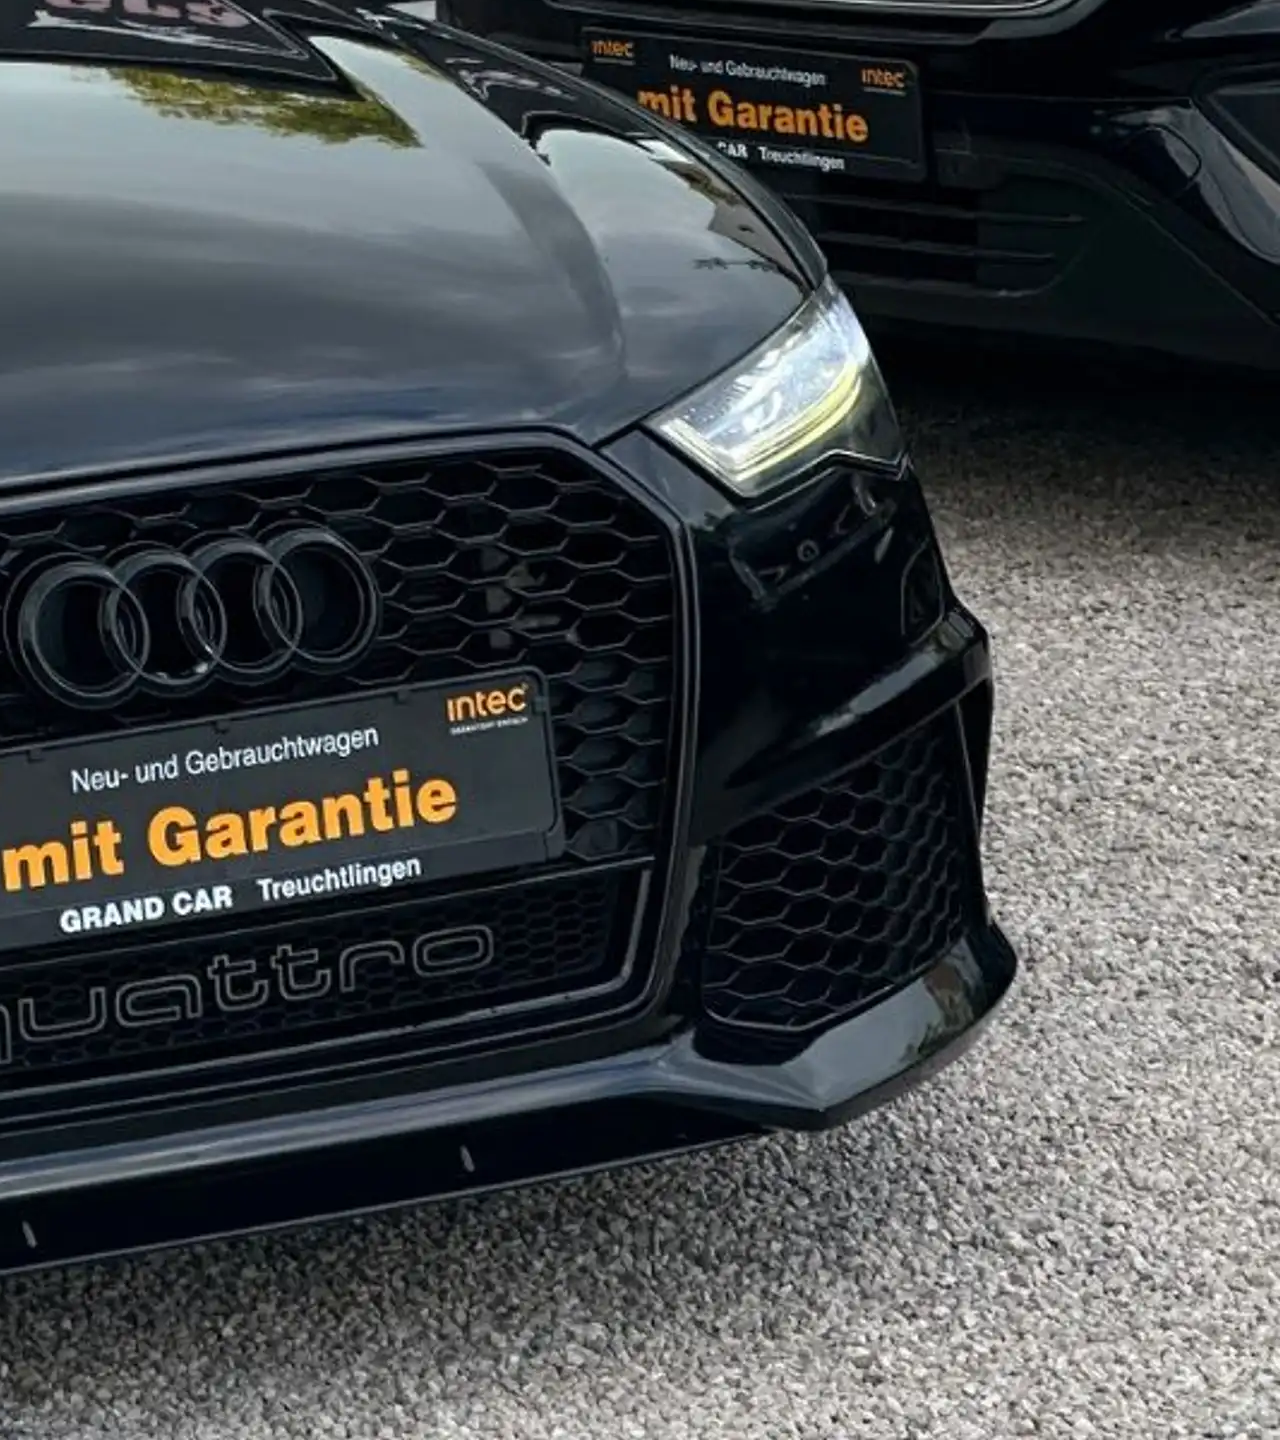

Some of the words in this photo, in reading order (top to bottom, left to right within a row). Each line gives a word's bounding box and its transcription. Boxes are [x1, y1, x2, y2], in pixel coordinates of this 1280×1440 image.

[637, 84, 698, 123] mit
[707, 90, 869, 142] Garantie
[446, 686, 528, 723] intec
[71, 769, 130, 795] Neu-
[136, 755, 180, 784] und
[185, 724, 380, 776] Gebrauchtwagen
[1, 819, 125, 892] mit
[147, 768, 459, 867] Garantie
[60, 895, 165, 934] GRAND
[172, 884, 234, 918] CAR
[256, 857, 422, 902] Treuchtlingen
